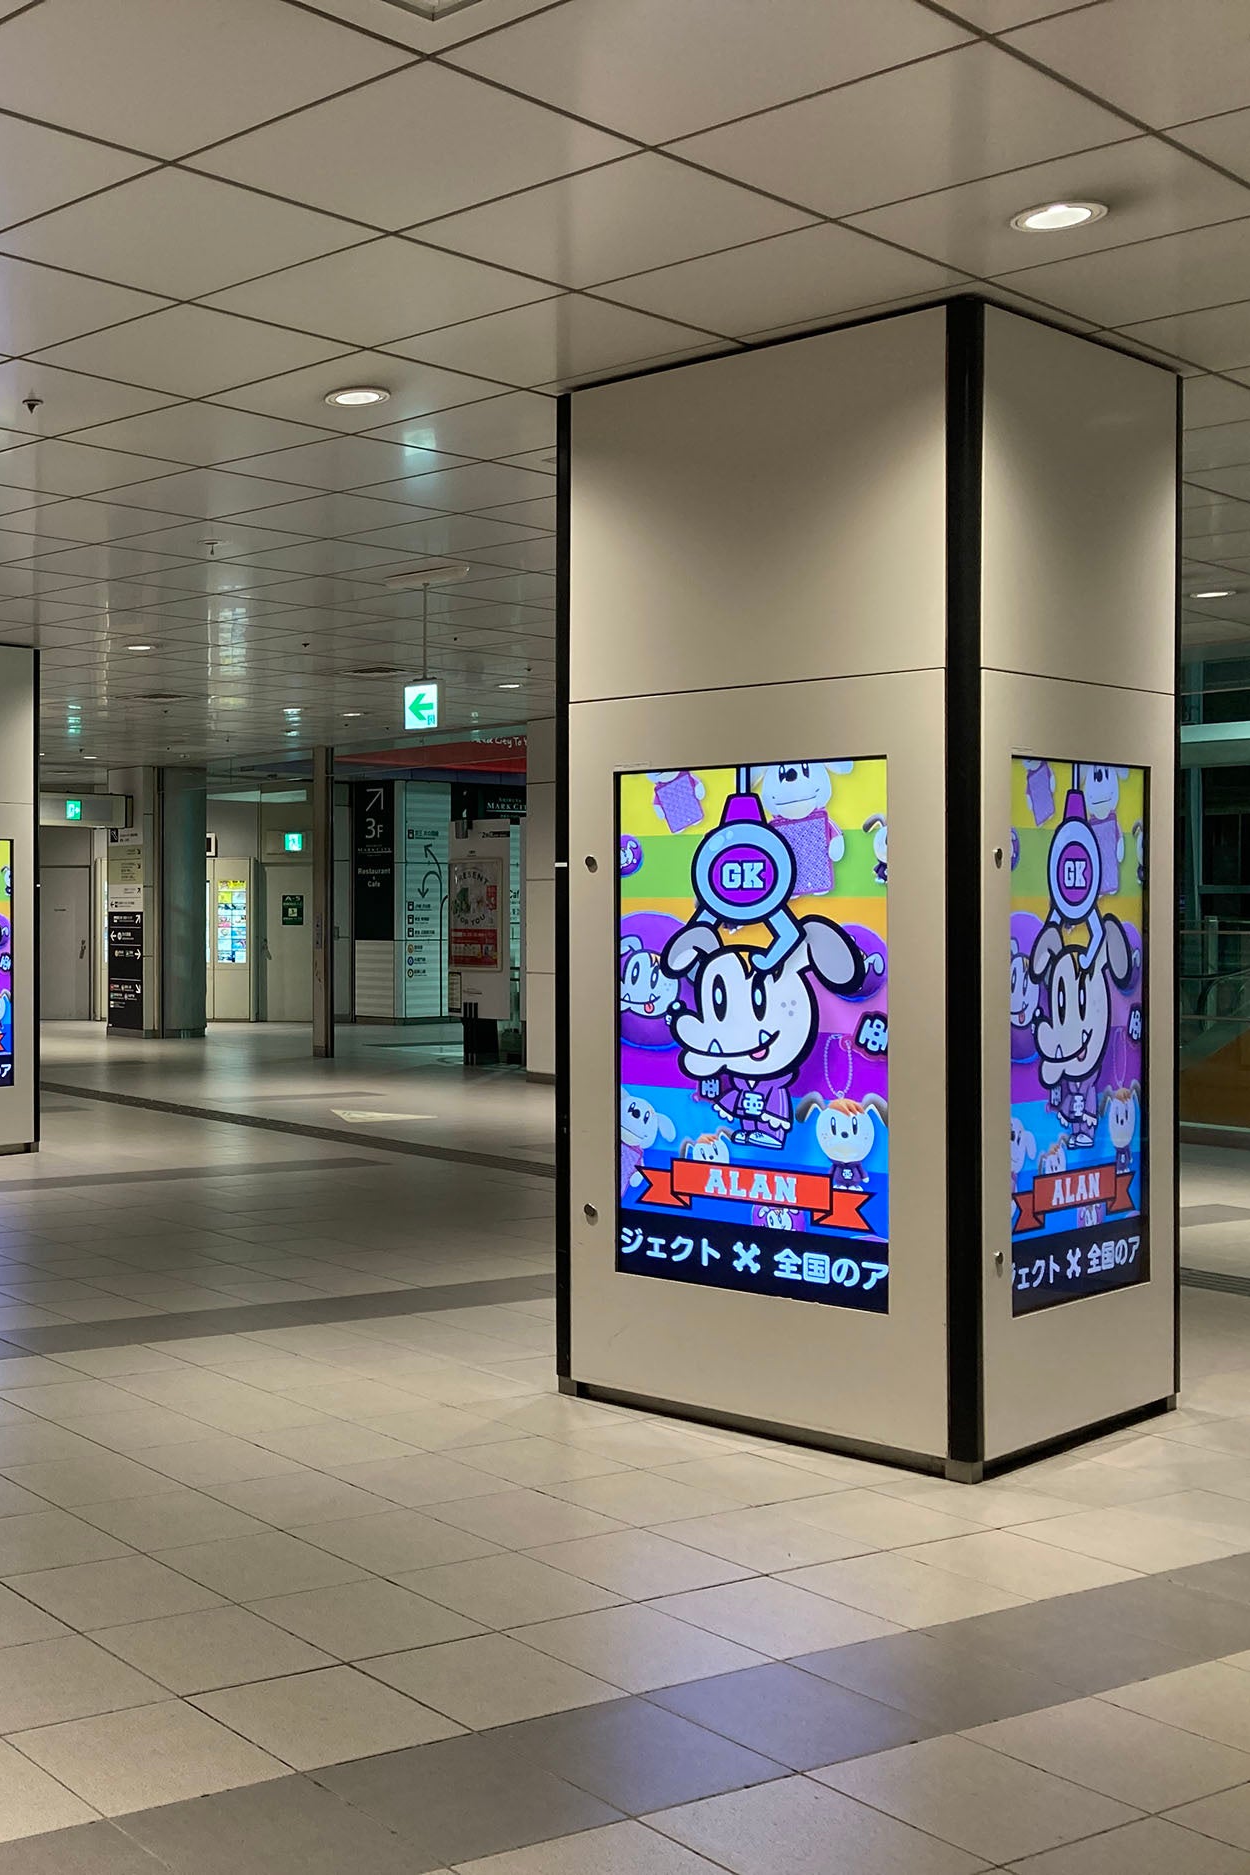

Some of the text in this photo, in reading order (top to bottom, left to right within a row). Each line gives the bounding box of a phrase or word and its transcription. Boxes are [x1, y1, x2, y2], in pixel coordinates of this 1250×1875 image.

[486, 802, 511, 810] MARK
[365, 818, 384, 839] 3F
[357, 867, 391, 875] Restaurant
[721, 862, 767, 890] GK
[1064, 860, 1087, 888] GK
[704, 1168, 798, 1204] ALAN
[1052, 1172, 1100, 1206] ALAN
[621, 1227, 888, 1290] ジェクト 全国のア
[1087, 1235, 1140, 1274] 全国のア
